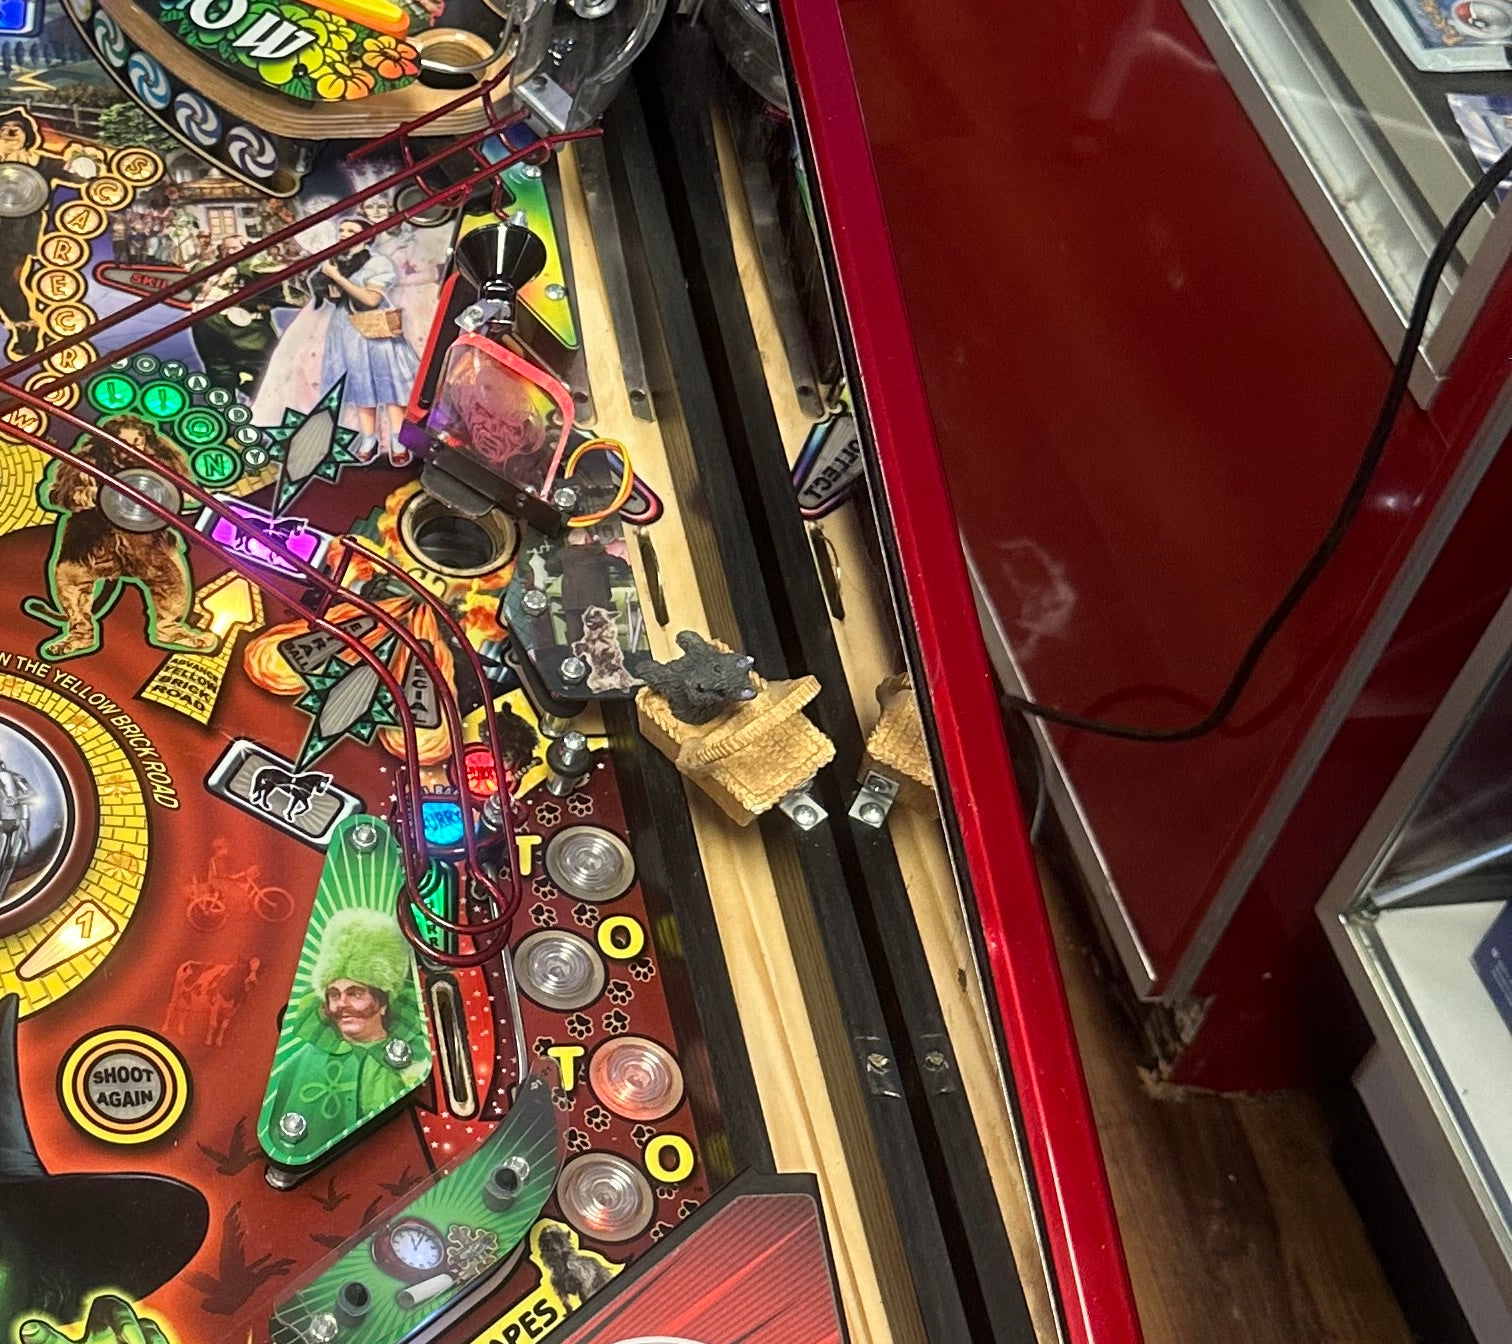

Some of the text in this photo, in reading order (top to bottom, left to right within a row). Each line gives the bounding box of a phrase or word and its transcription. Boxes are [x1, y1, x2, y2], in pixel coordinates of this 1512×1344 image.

[163, 664, 218, 695] YELLOW
[170, 656, 219, 683] ADVANCE
[151, 683, 207, 714] ROAD
[157, 674, 212, 703] BRICK
[15, 654, 49, 679] THE
[52, 667, 120, 715] YELLOW
[109, 712, 160, 760] BRICK
[141, 759, 180, 811] ROAD
[92, 1065, 155, 1086] SHOOT
[95, 1088, 155, 1109] AGAIN
